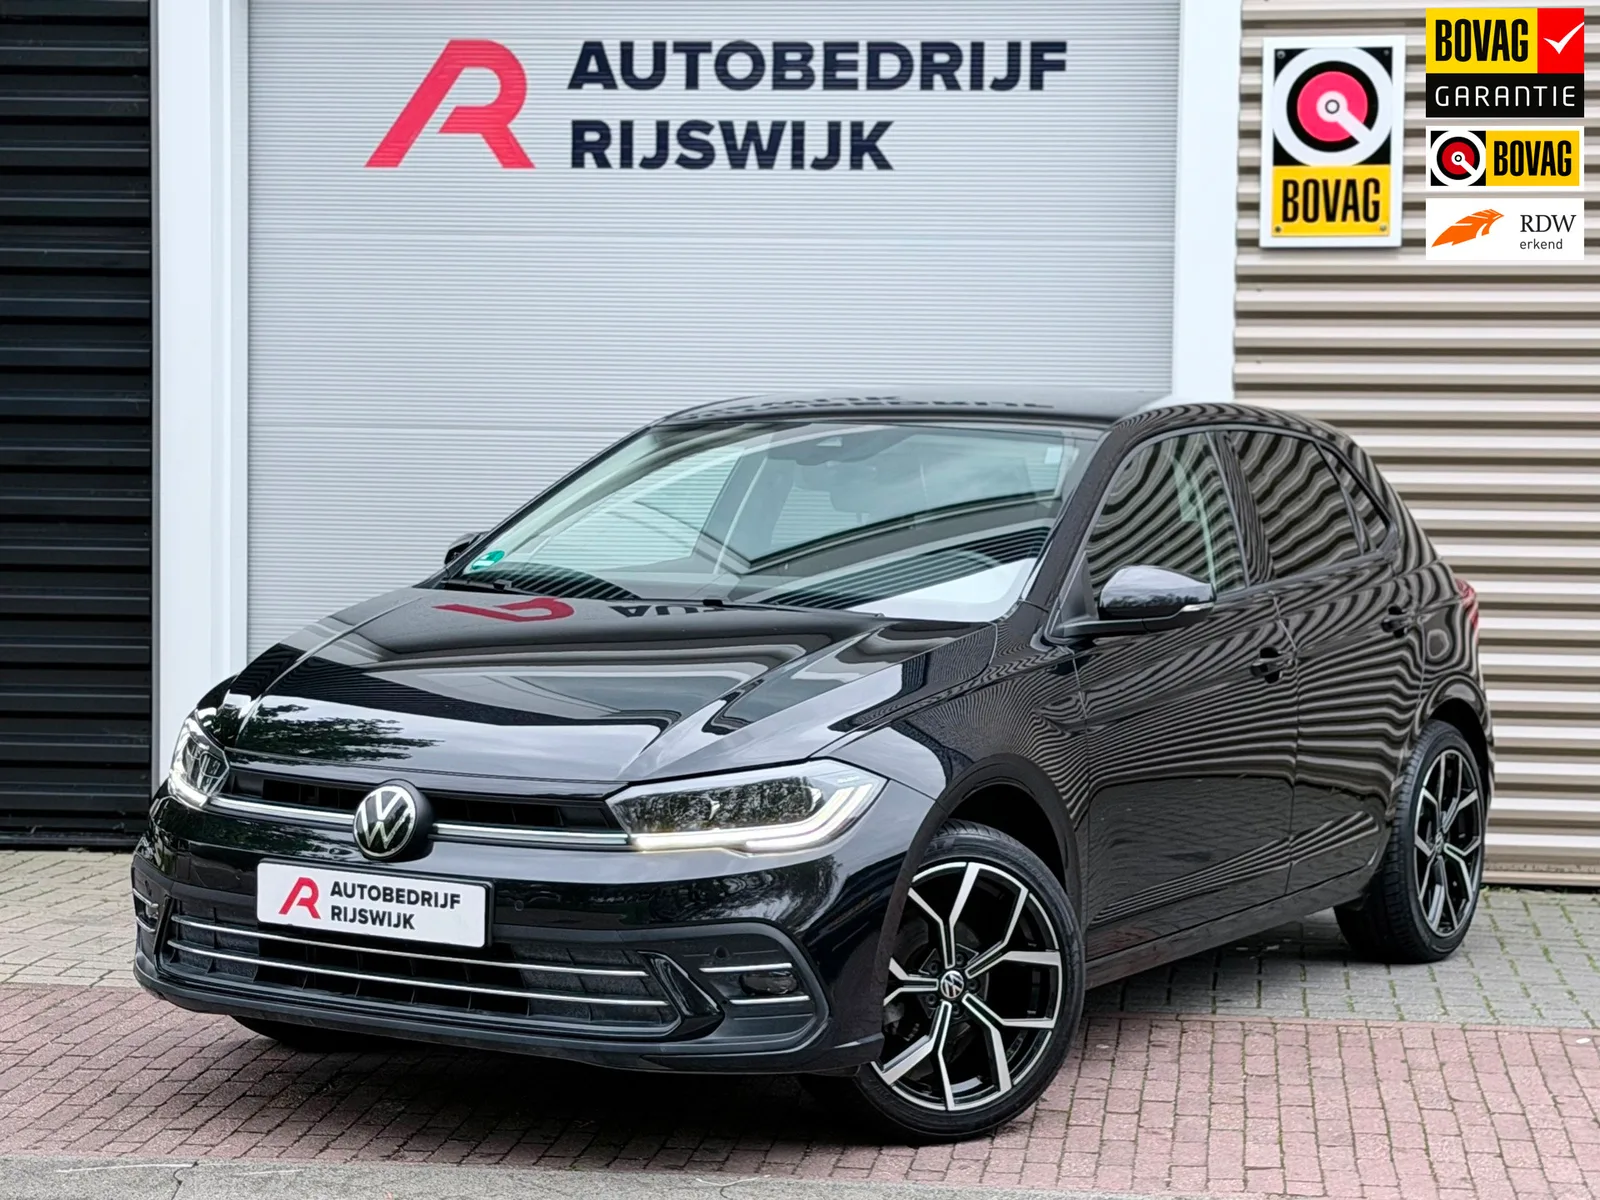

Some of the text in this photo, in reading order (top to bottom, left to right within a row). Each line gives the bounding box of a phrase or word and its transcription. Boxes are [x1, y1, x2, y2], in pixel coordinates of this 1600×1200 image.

[567, 41, 1068, 91] AUTOBEDRIJF
[570, 120, 895, 171] RIJSWIJK
[1282, 178, 1381, 223] BOVAG
[330, 880, 461, 910] AUTOBEDRIJF
[330, 905, 415, 930] RIJSWIJK
